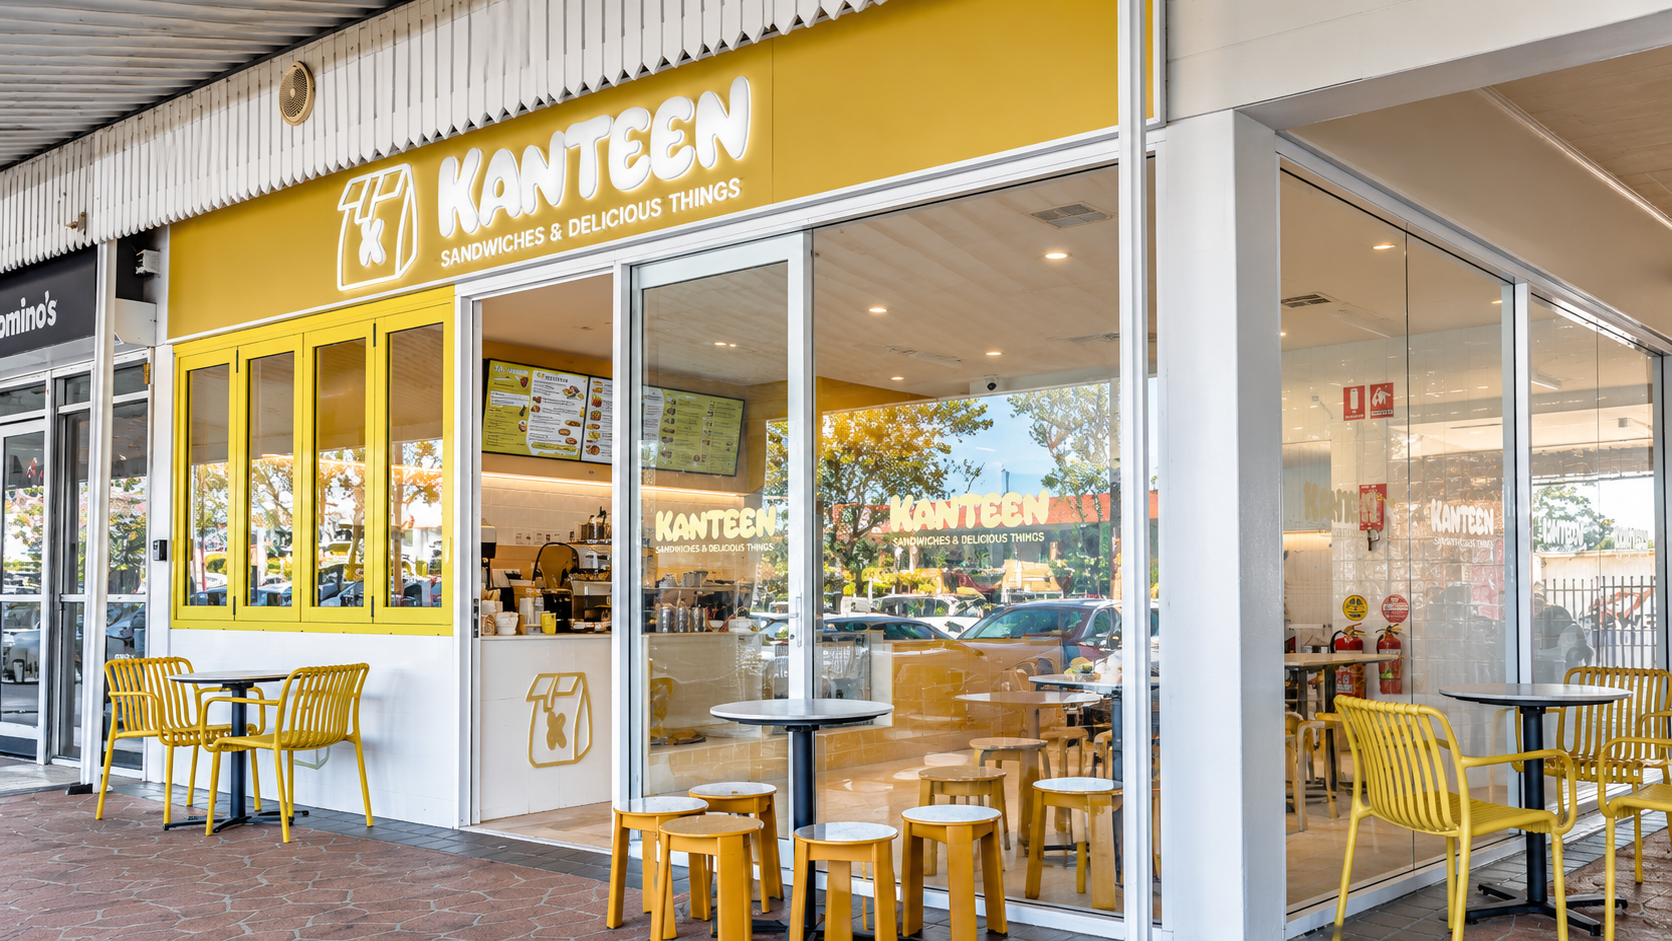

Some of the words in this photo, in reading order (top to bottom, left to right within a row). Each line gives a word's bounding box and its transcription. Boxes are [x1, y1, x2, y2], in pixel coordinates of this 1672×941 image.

[438, 75, 751, 238] KANTEEN
[358, 218, 386, 267] K
[441, 228, 545, 267] SANDWICHES
[550, 223, 563, 242] &
[568, 198, 662, 238] DELICIOUS
[668, 177, 741, 213] THINGS
[655, 505, 777, 543] KANTEEN
[889, 488, 1050, 533] KANTEEN
[1431, 498, 1494, 536] KANTEEN
[961, 533, 1008, 545] DELICIOUS
